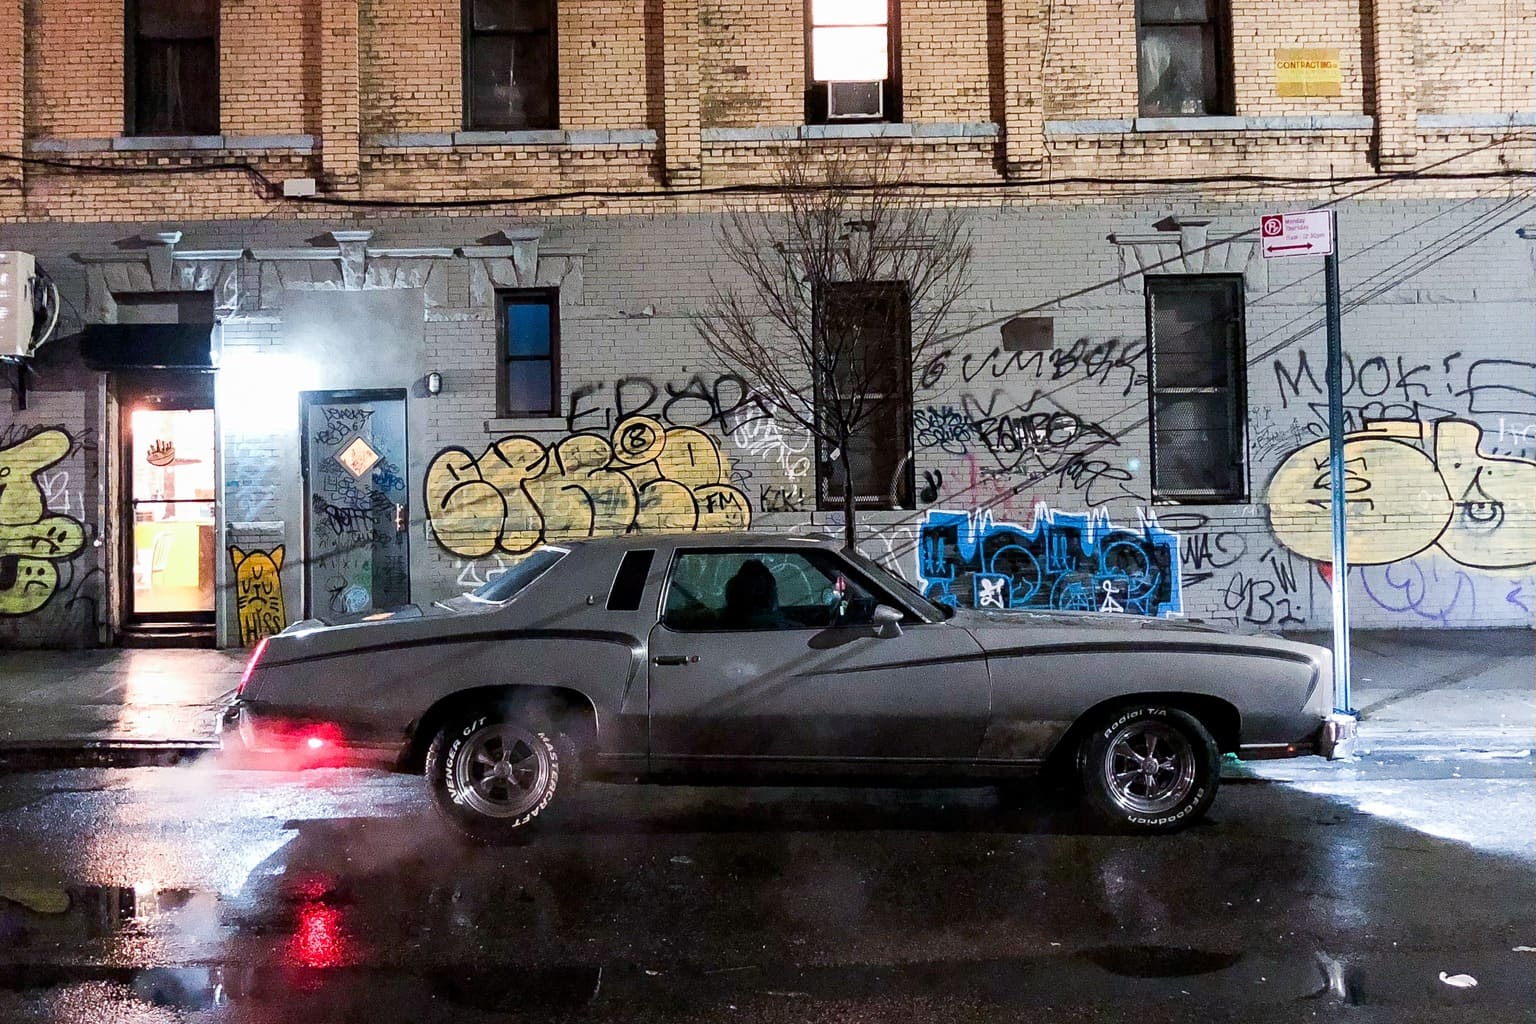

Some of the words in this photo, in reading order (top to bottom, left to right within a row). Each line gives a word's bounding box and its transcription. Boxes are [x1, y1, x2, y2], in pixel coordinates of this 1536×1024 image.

[1285, 217, 1305, 225] Monday
[462, 716, 487, 737] G/T
[1104, 709, 1143, 739] Radial
[1146, 708, 1167, 717] T/A
[1127, 787, 1206, 825] BFGoodrich
